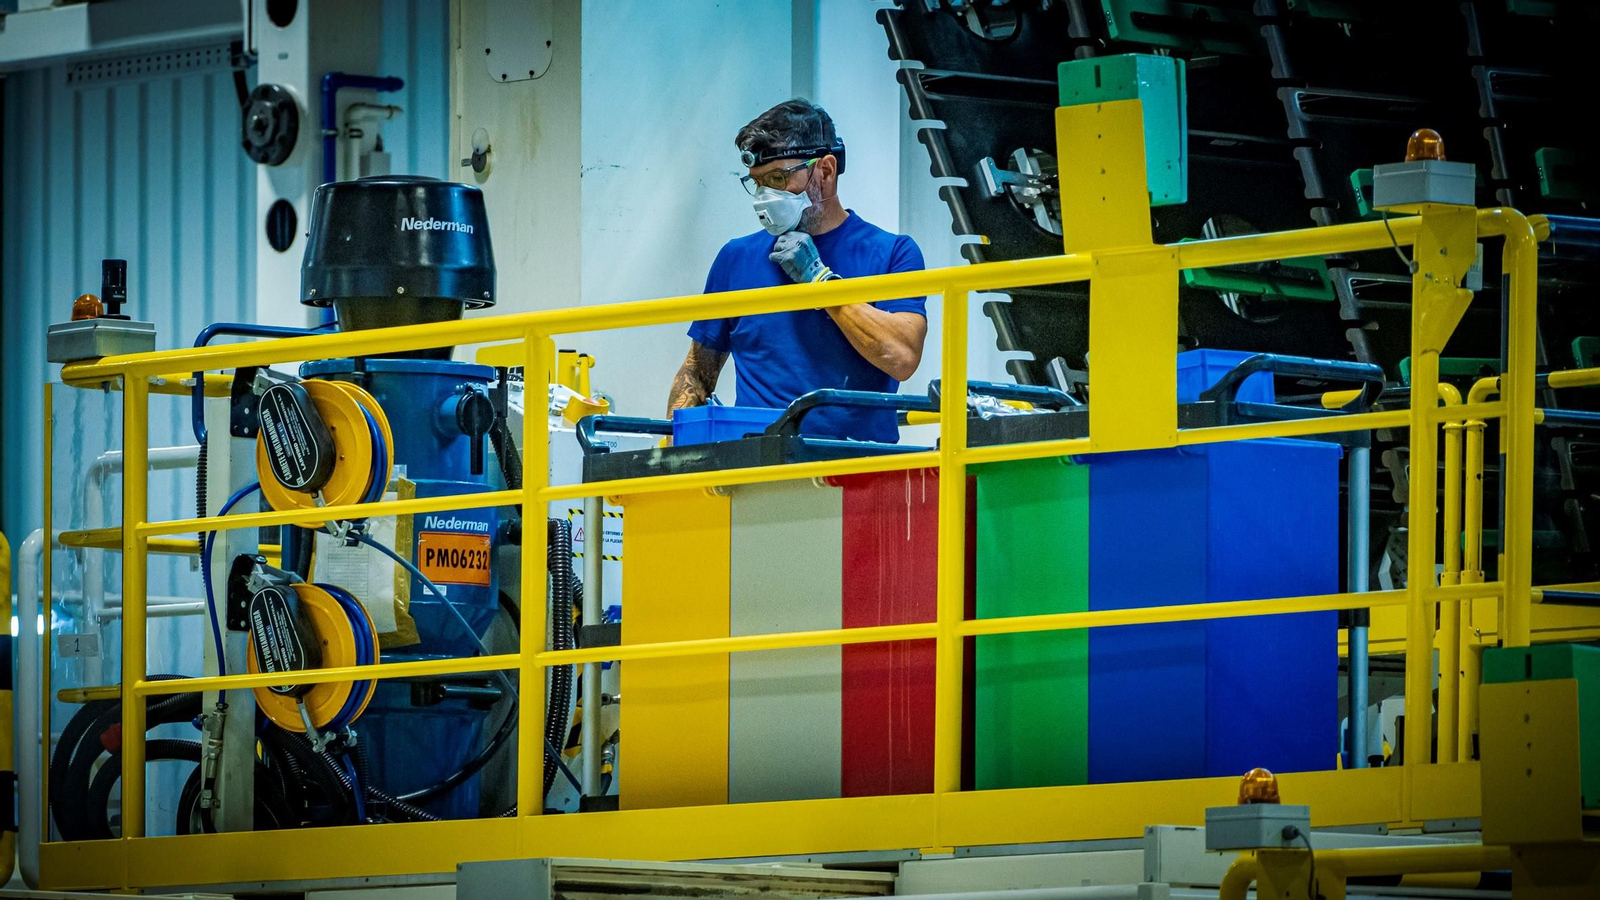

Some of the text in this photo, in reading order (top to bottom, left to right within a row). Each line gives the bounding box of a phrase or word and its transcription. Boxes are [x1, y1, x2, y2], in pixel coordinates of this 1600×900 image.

[401, 217, 474, 234] Nederman
[262, 408, 284, 457] PORTAMANGUERA
[278, 454, 293, 481] CARRETE
[424, 516, 489, 531] Nederman
[425, 548, 488, 570] PM06232
[74, 638, 80, 652] 1
[253, 609, 272, 659] PORTAMANGUERA
[280, 647, 290, 671] ARWIND
